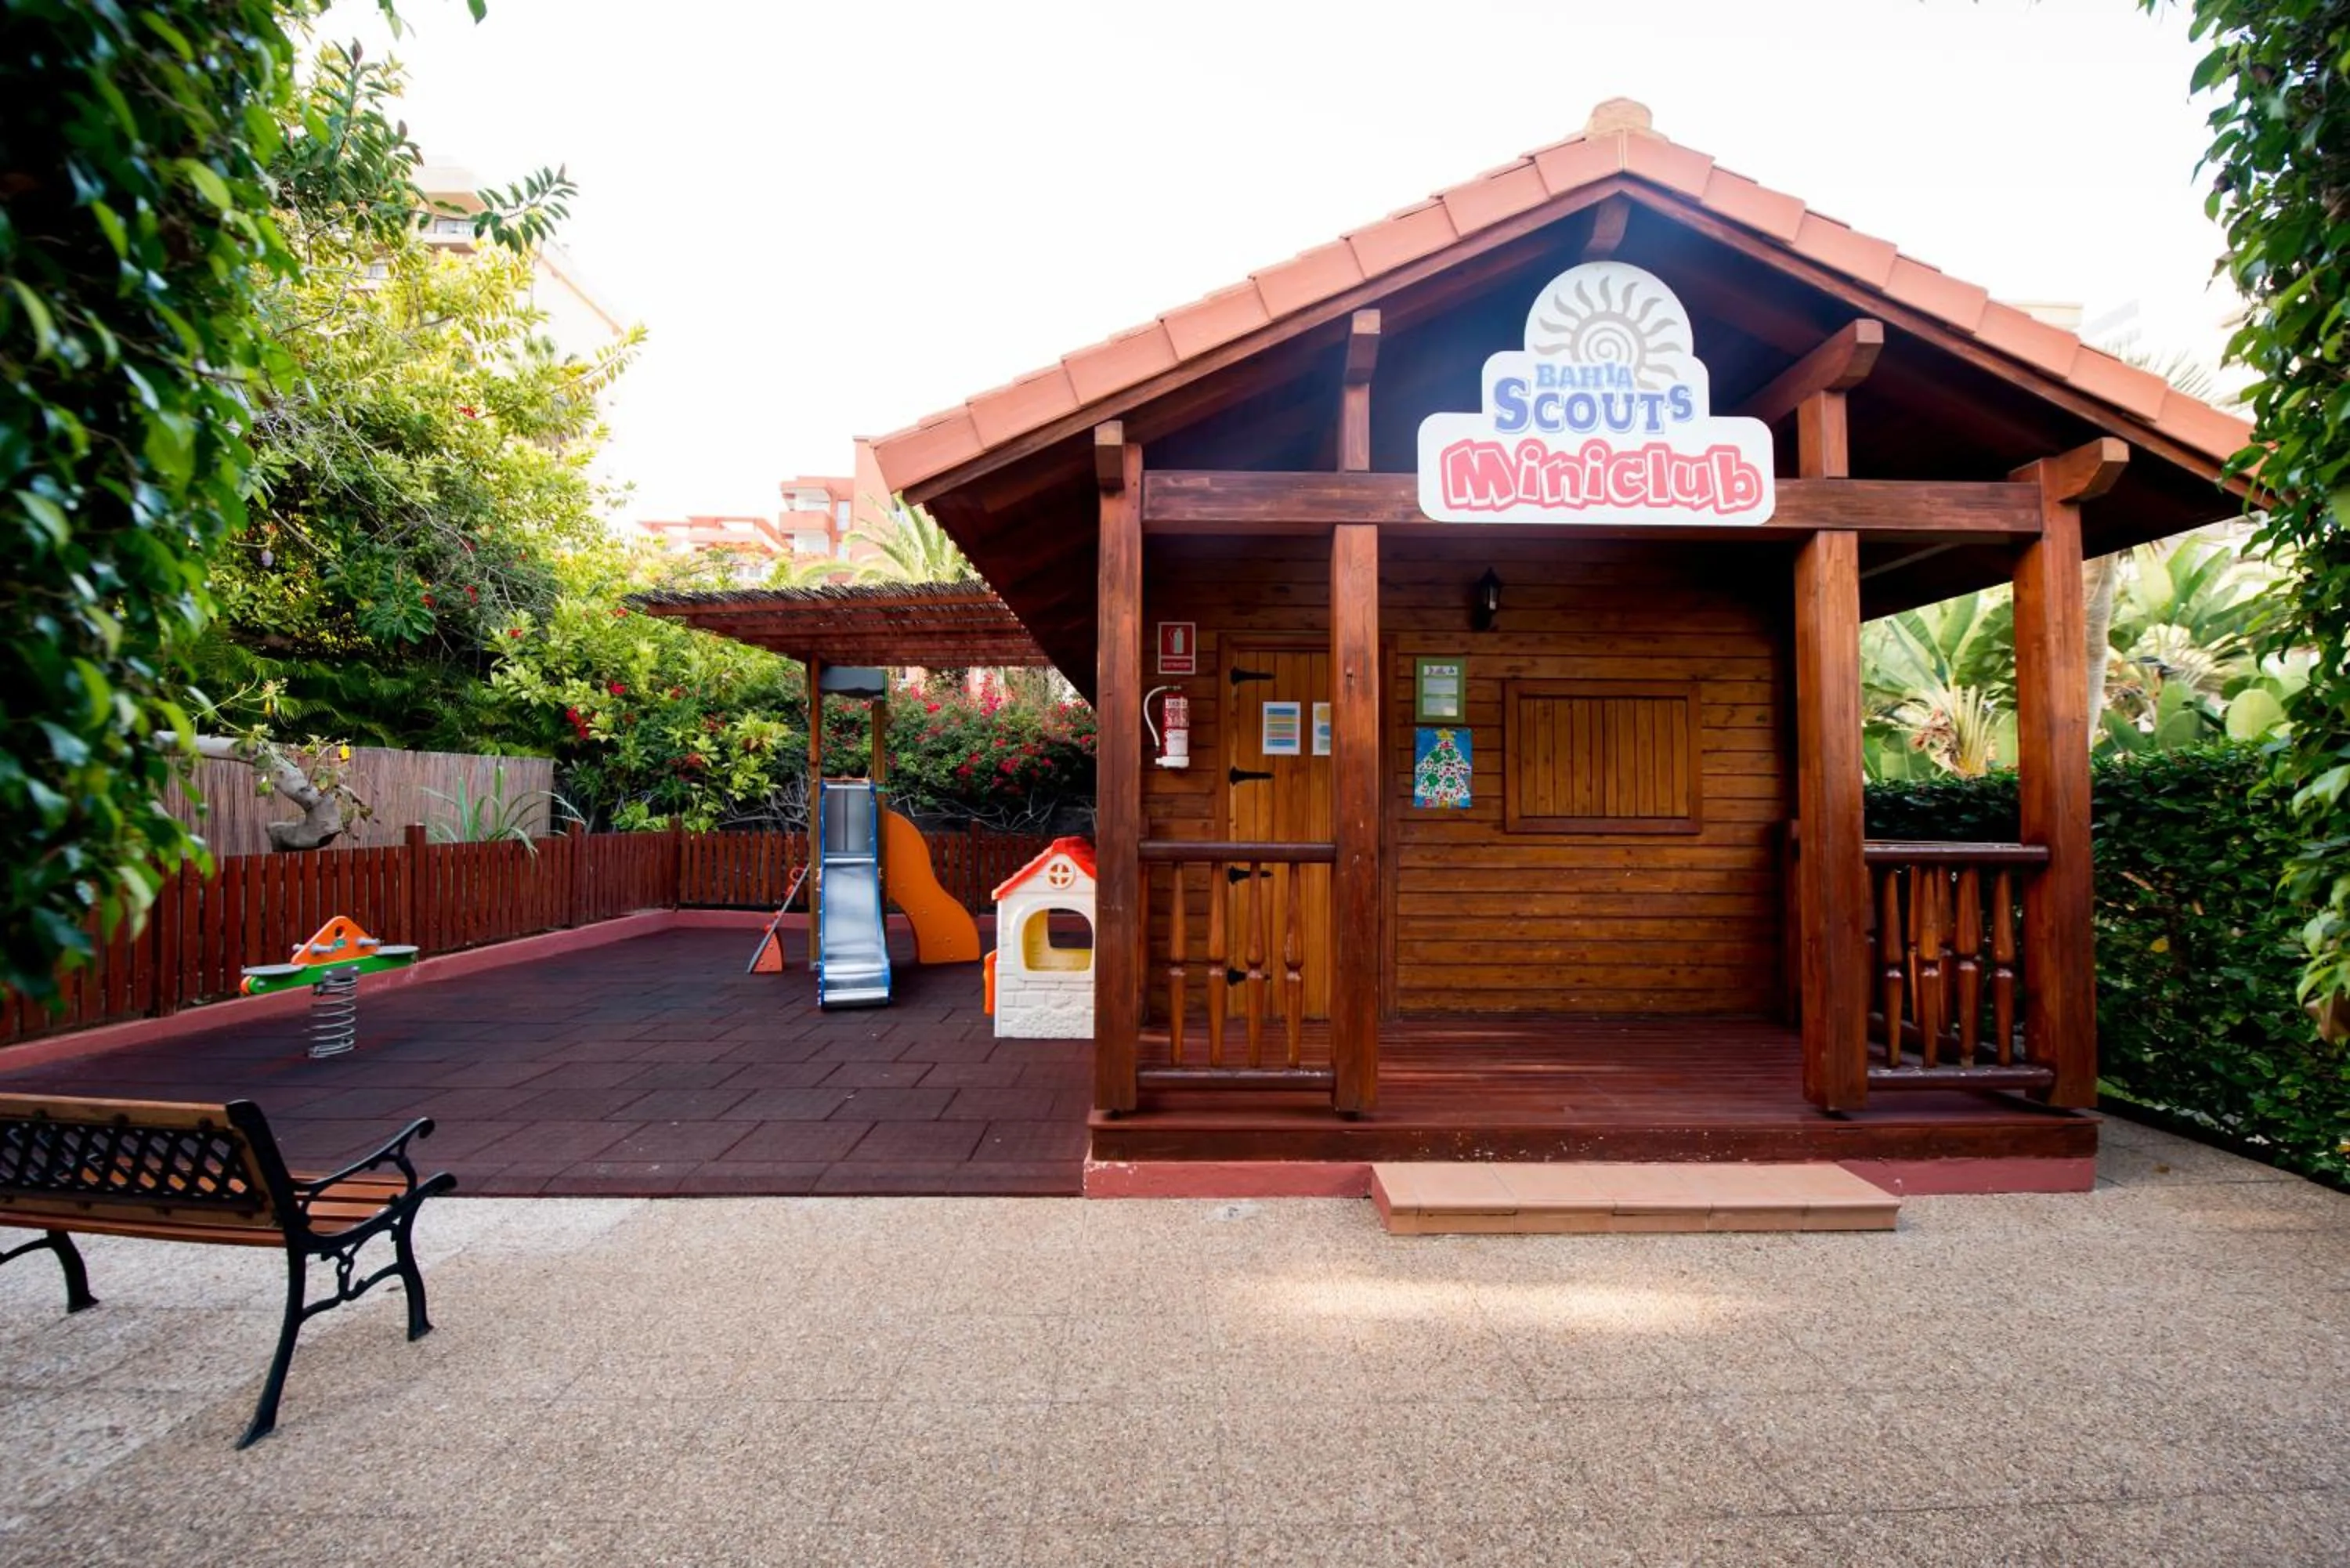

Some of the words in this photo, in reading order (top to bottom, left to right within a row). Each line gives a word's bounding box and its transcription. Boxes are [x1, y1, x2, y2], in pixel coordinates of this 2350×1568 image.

[1535, 363, 1633, 388] BAHIA
[1494, 378, 1693, 433] SCOUTS
[1441, 439, 1763, 515] Miniclub
